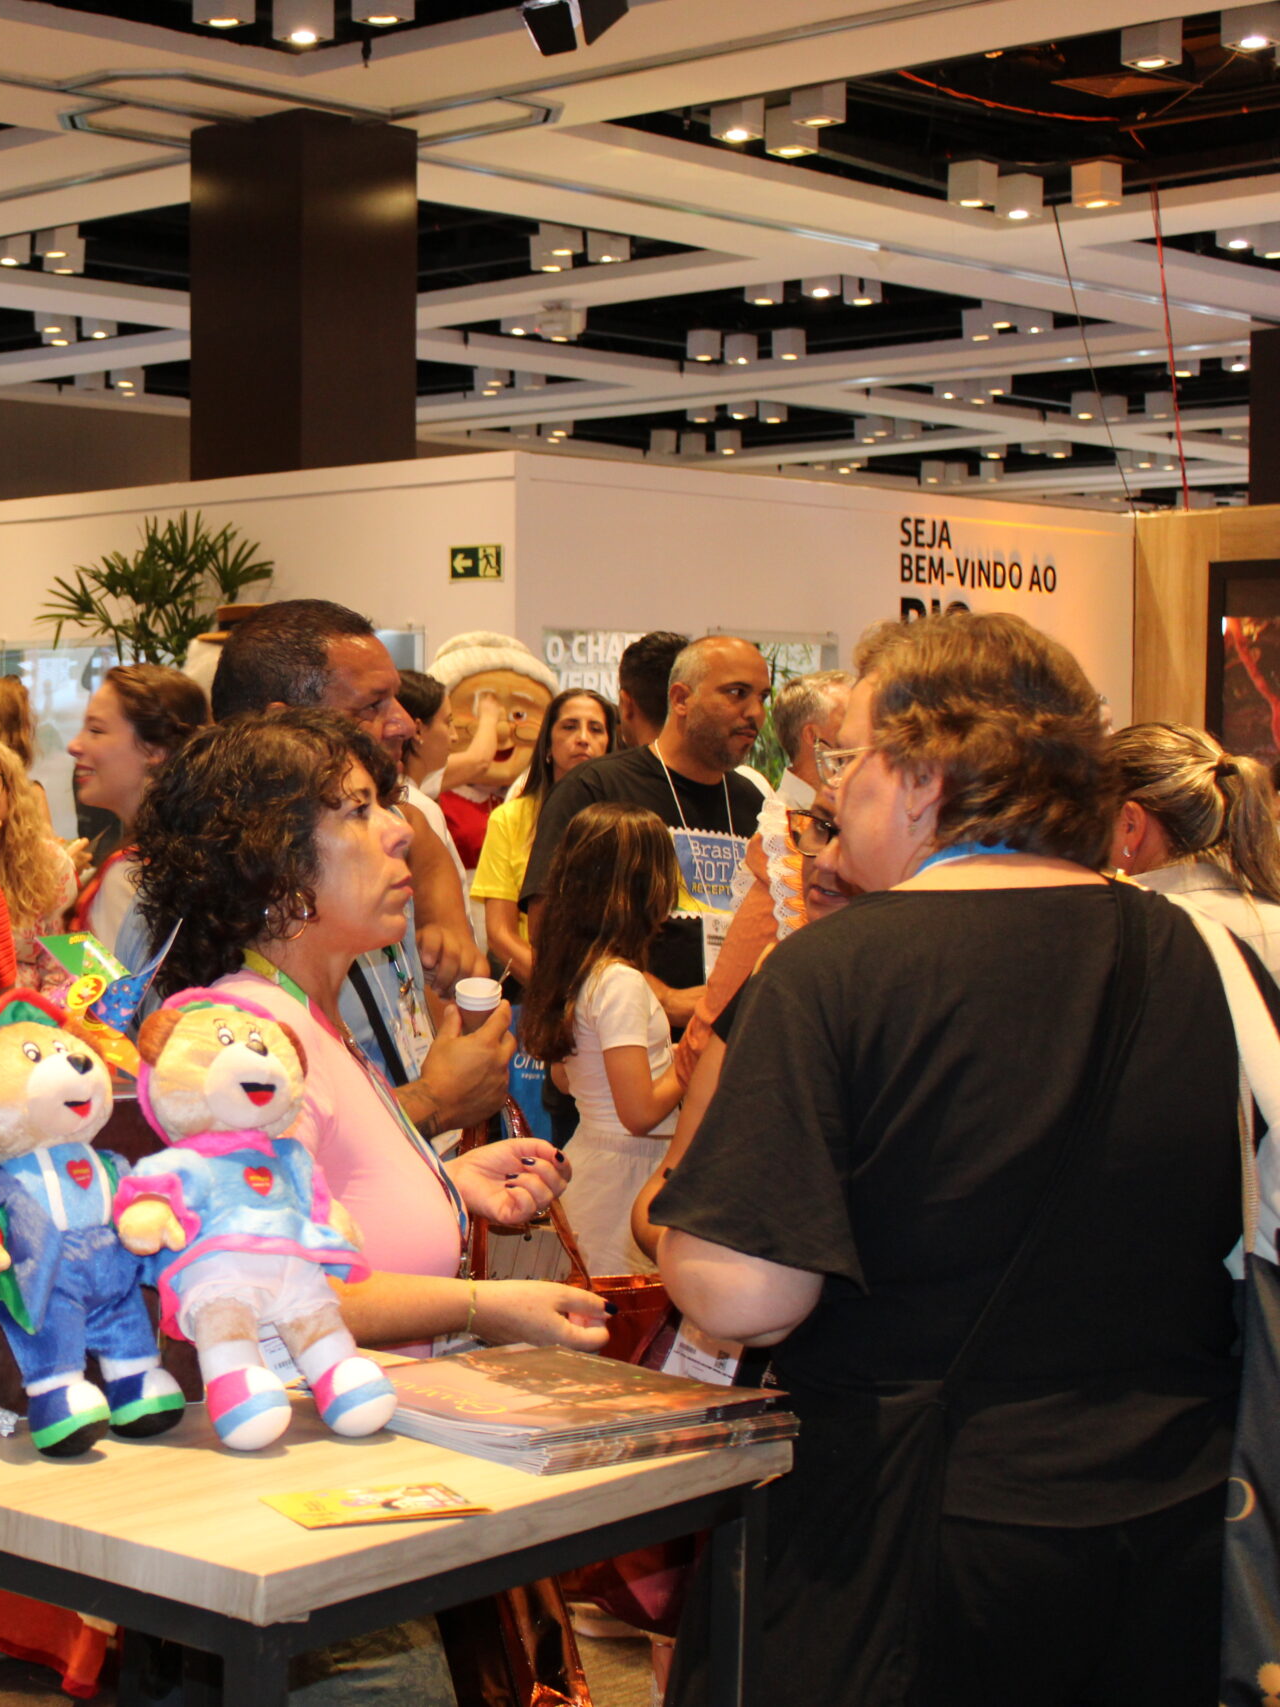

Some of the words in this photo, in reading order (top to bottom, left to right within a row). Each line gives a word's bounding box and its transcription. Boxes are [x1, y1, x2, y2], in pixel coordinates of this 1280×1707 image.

[900, 516, 952, 550] SEJA
[900, 552, 1023, 592] BEM-VINDO
[1028, 563, 1057, 593] AO
[692, 859, 734, 882] TOT
